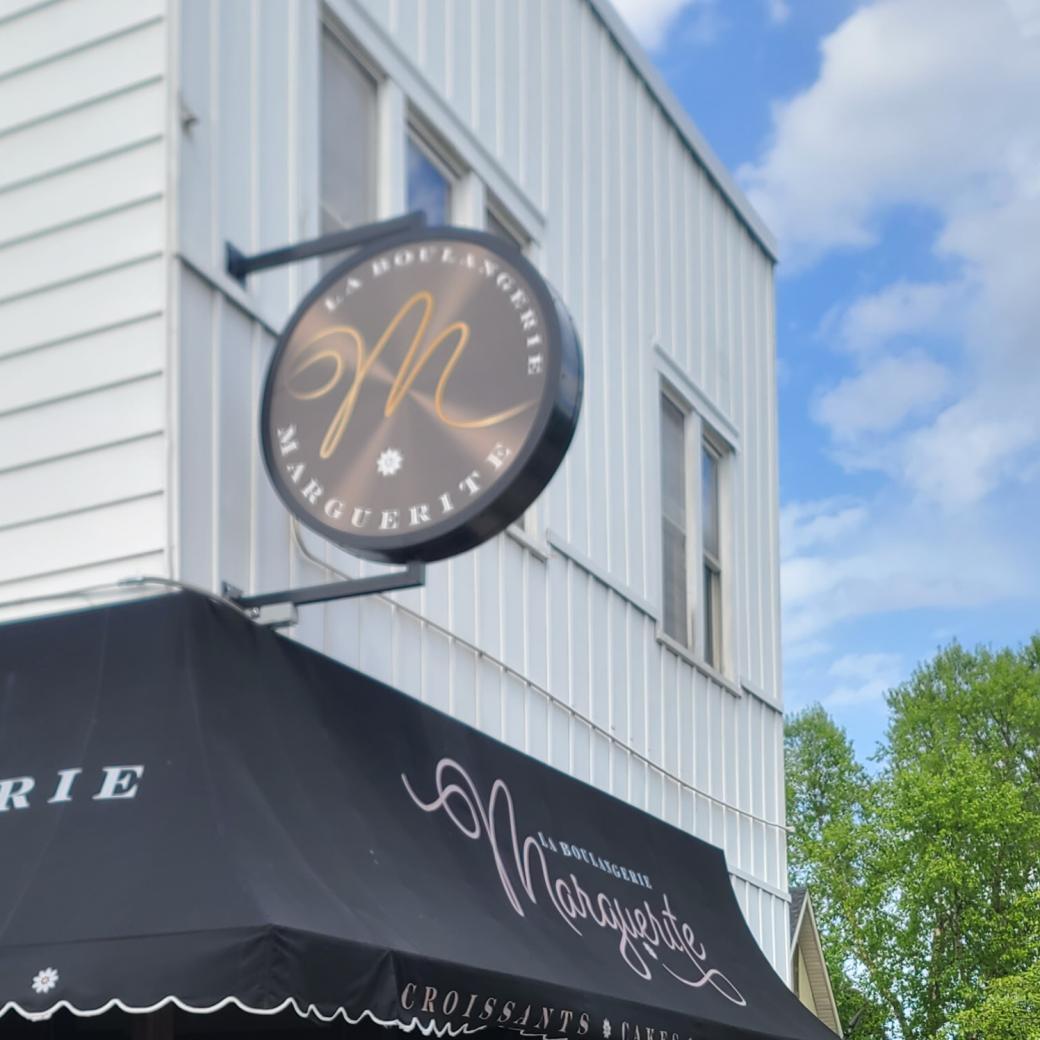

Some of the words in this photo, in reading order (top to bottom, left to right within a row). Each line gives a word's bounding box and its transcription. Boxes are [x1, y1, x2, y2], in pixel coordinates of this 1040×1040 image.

[324, 276, 363, 311] LA
[371, 246, 543, 376] BOULANGERIE
[277, 424, 513, 531] MARGUERITE
[401, 758, 746, 1006] Marguerite
[537, 831, 558, 853] LA
[558, 841, 654, 890] BOULANGERIE
[401, 982, 590, 1035] CROISSANTS
